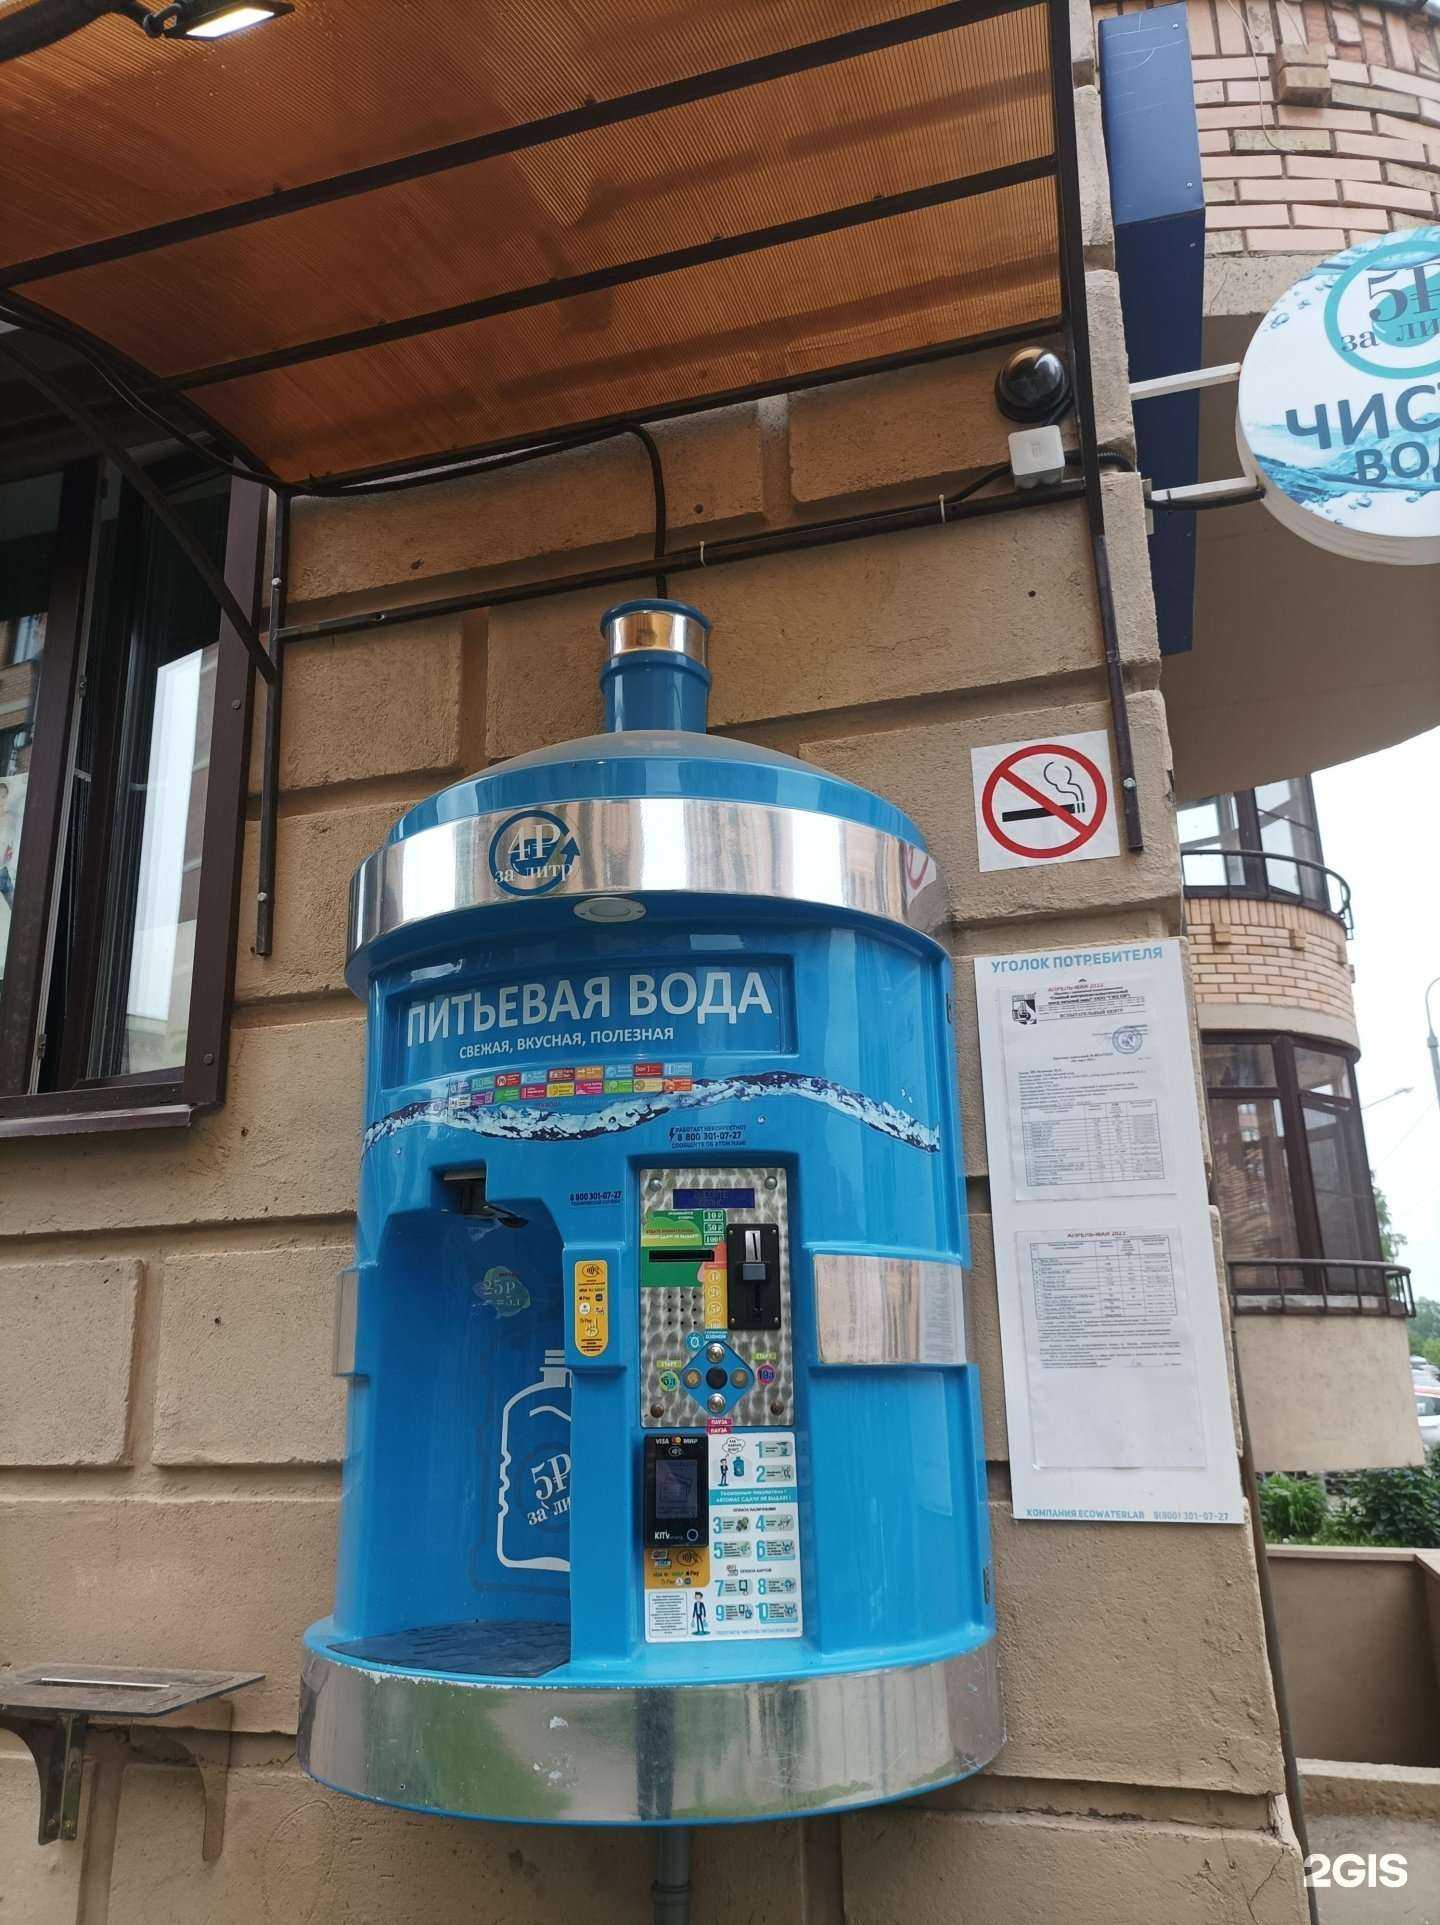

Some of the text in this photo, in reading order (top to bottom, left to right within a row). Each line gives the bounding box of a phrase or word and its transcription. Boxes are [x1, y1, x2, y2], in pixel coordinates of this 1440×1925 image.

[1341, 331, 1379, 352] за
[1285, 382, 1440, 450] ЧИС
[494, 868, 515, 882] за
[990, 946, 1163, 973] УГОЛОК ПОТРЕБИТЕЛЯ
[407, 971, 773, 1048] ПИТЬЕВАЯ ВОДА
[459, 1027, 674, 1060] СВЕЖАЯ, ВКУСНАЯ, ПОЛЕЗНАЯ
[677, 1131, 742, 1142] 8 800 301-07-27
[755, 1441, 762, 1458] 1
[756, 1465, 765, 1483] 2
[527, 1507, 548, 1526] за
[1026, 1508, 1077, 1519] КОМПАНИЯ
[1078, 1509, 1145, 1519] ECOWATERLAB
[713, 1516, 722, 1534] 3
[756, 1515, 765, 1532] 4
[713, 1542, 723, 1559] 5
[756, 1540, 765, 1559] 6
[714, 1579, 724, 1597] 7
[758, 1578, 766, 1595] 8
[715, 1604, 724, 1621] 9
[755, 1602, 768, 1622] 10
